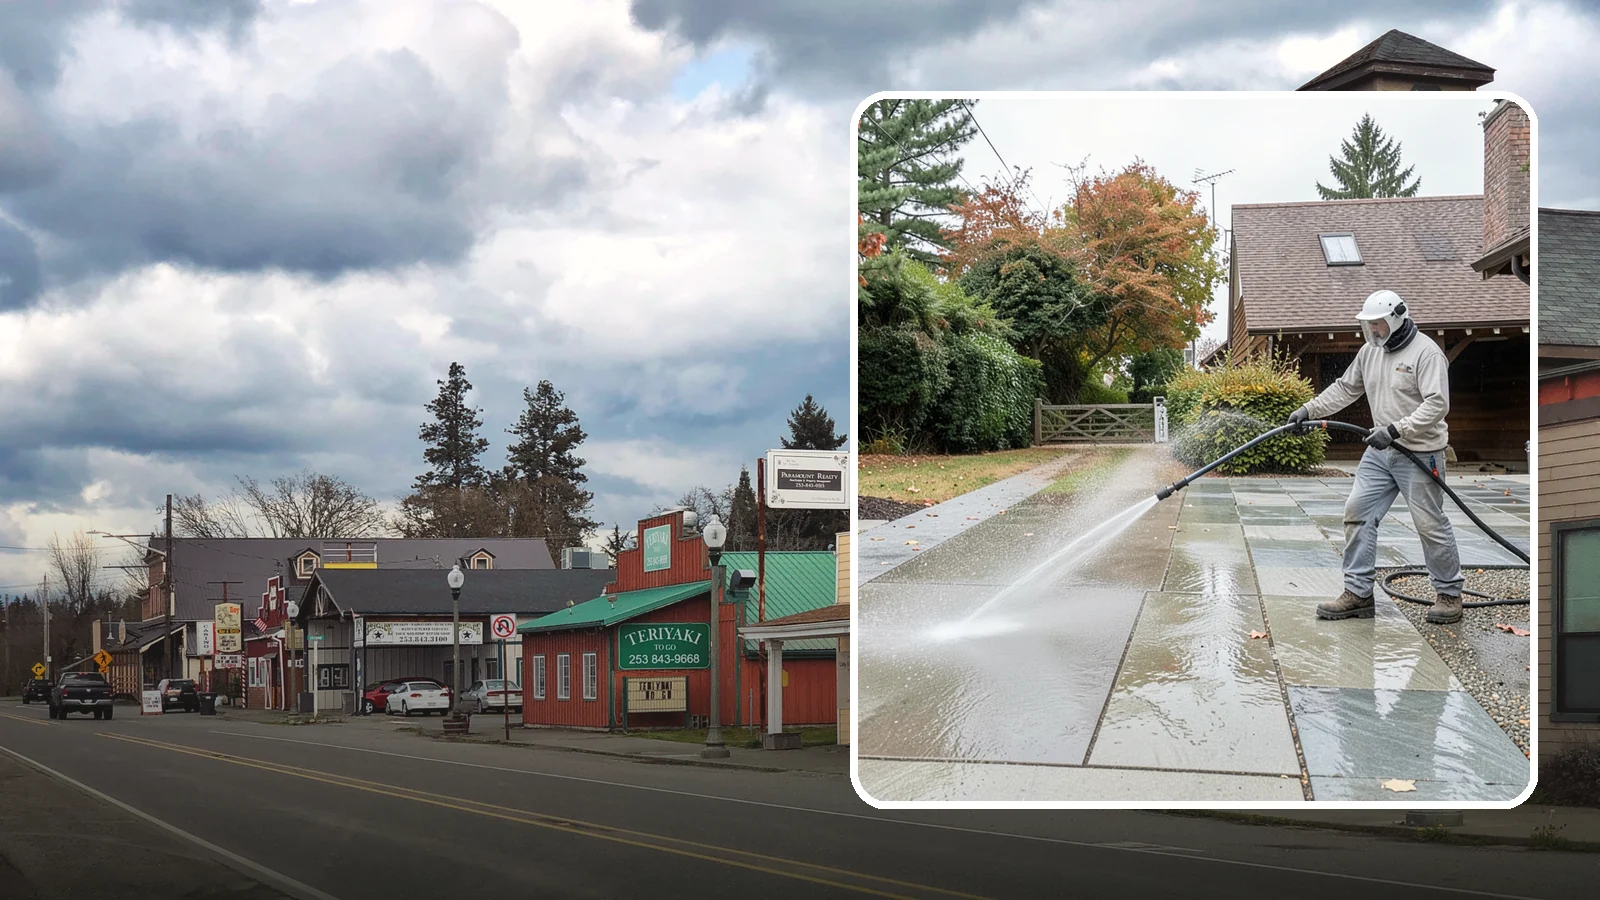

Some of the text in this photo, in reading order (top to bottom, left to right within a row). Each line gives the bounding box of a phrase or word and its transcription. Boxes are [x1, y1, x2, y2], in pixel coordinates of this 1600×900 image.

[781, 471, 815, 479] PARAMOUNT
[646, 531, 669, 549] TERIYAKI
[624, 627, 702, 646] TERIYAKI
[629, 653, 700, 664] 253 843-9668
